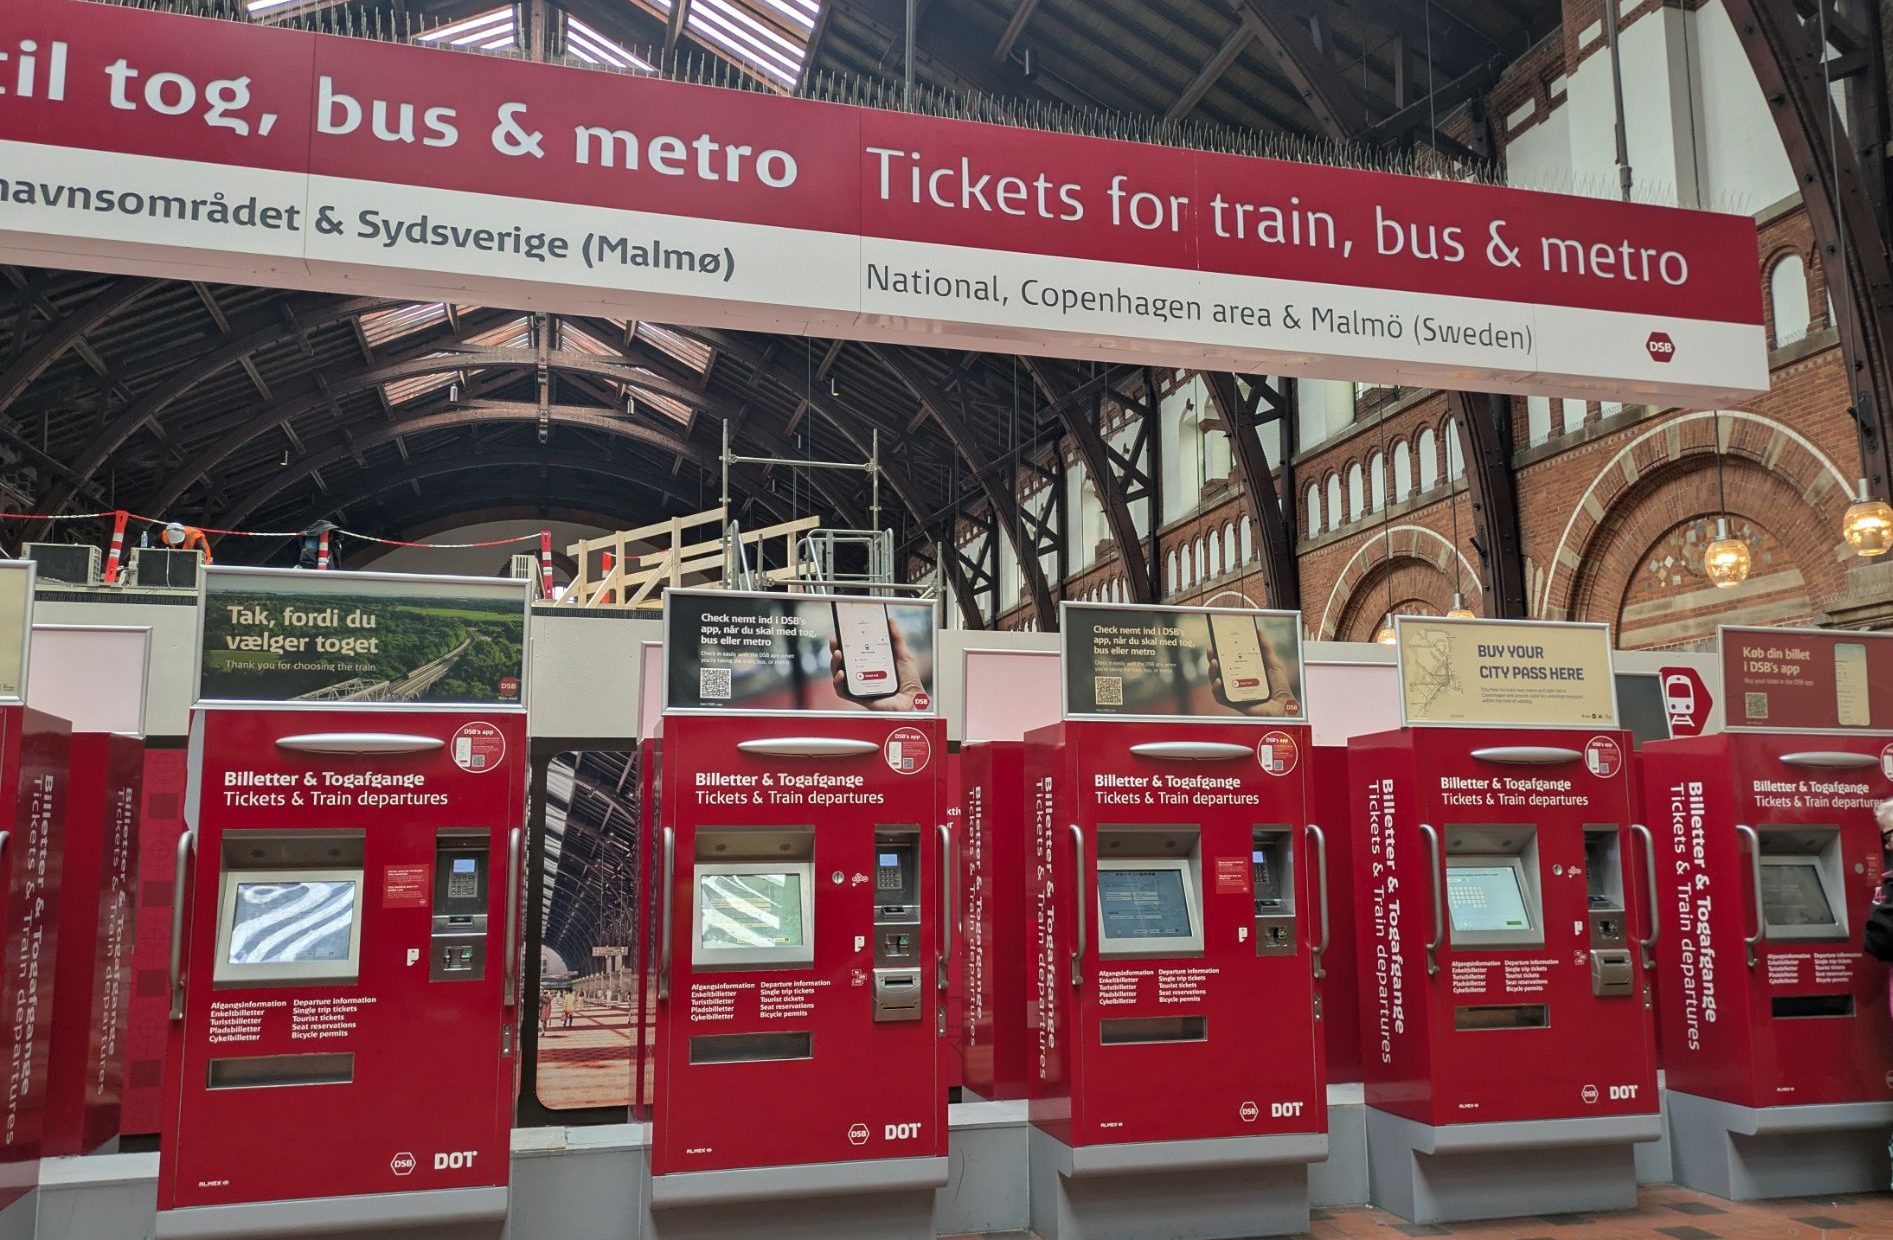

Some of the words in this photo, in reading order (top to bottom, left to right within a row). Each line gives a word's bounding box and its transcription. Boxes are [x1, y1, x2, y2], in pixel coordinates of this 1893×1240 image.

[0, 40, 67, 101] il
[104, 58, 277, 136] tog,
[317, 76, 459, 147] bus
[491, 102, 544, 159] &
[575, 125, 798, 188] metro
[866, 146, 1084, 222] Tickets
[1106, 175, 1189, 232] for
[1210, 193, 1352, 259] train,
[1376, 204, 1465, 263] bus
[1486, 219, 1521, 268] &
[1541, 235, 1688, 286] metro
[315, 205, 344, 235] &
[358, 210, 569, 262] Sydsverige
[582, 233, 735, 282] (Malmø)
[867, 263, 1008, 306] National,
[1020, 279, 1201, 322] Copenhagen
[1212, 303, 1271, 327] area
[1283, 304, 1301, 330] &
[1312, 306, 1403, 339] Malmö
[1414, 314, 1532, 356] (Sweden)
[1649, 340, 1673, 353] DSB
[226, 605, 274, 629] Tak,
[283, 606, 339, 628] fordi
[346, 609, 377, 629] du
[701, 613, 729, 623] Check
[731, 615, 756, 623] nemt
[758, 615, 773, 624] ind
[781, 616, 806, 624] DSB's
[700, 627, 721, 636] app,
[723, 624, 741, 634] når
[743, 626, 754, 635] du
[756, 626, 774, 635] skal
[777, 627, 796, 636] med
[1093, 625, 1118, 634] Check
[1120, 626, 1142, 635] nemt
[1143, 626, 1156, 635] ind
[226, 631, 309, 655] vælger
[316, 636, 379, 657] toget
[701, 636, 718, 645] bus
[720, 636, 741, 645] eller
[743, 638, 771, 646] metro
[1093, 637, 1112, 646] app,
[1113, 636, 1128, 644] når
[1129, 637, 1139, 645] du
[1141, 637, 1158, 645] skal
[1159, 638, 1178, 646] med
[1094, 646, 1109, 654] bus
[1111, 647, 1129, 655] eller
[1131, 648, 1155, 656] metro
[1478, 644, 1505, 658] BUY
[1507, 645, 1543, 659] YOUR
[1743, 647, 1764, 658] Køb
[1767, 648, 1783, 659] din
[1785, 649, 1810, 660] billet
[225, 659, 255, 670] Thank
[257, 662, 275, 672] you
[277, 660, 291, 671] for
[293, 661, 335, 673] choosing
[338, 662, 353, 672] the
[355, 663, 376, 672] train
[1479, 665, 1509, 679] CITY
[1513, 666, 1547, 680] PASS
[1549, 667, 1584, 681] HERE
[1750, 662, 1778, 673] DSB's
[1780, 665, 1800, 675] app
[501, 682, 516, 690] DSB
[224, 771, 300, 786] Billetter
[304, 772, 317, 786] &
[322, 771, 425, 789] Togafgange
[695, 773, 759, 786] Billetter
[763, 773, 774, 786] &
[777, 773, 864, 788] Togafgange
[1095, 774, 1149, 787] Billetter
[1152, 775, 1162, 787] &
[1165, 775, 1241, 789] Togafgange
[1441, 777, 1489, 789] Billetter
[1492, 778, 1501, 789] &
[1503, 778, 1571, 792] Togafgange
[1753, 780, 1796, 792] Billetter
[1799, 781, 1807, 792] &
[1809, 781, 1869, 794] Togafgange
[224, 791, 285, 806] Tickets
[291, 792, 304, 806] &
[311, 791, 352, 806] Train
[358, 791, 449, 808] departures
[695, 791, 748, 804] Tickets
[752, 791, 763, 804] &
[768, 791, 803, 804] Train
[808, 790, 884, 806] departures
[1095, 792, 1141, 804] Tickets
[1145, 792, 1154, 804] &
[1158, 792, 1189, 804] Train
[1193, 791, 1259, 806] departures
[1442, 793, 1482, 805] Tickets
[1486, 793, 1495, 805] &
[1498, 793, 1526, 805] Train
[1529, 794, 1588, 808] departures
[1755, 795, 1791, 807] Tickets
[1794, 796, 1802, 807] &
[1805, 796, 1829, 807] Train
[27, 774, 42, 870] Tickets
[1368, 780, 1380, 854] Tickets
[1382, 779, 1396, 870] Billetter
[1670, 783, 1686, 853] Tickets
[37, 775, 53, 888] Billetter
[1688, 782, 1705, 868] Billetter
[1372, 862, 1383, 877] &
[1676, 860, 1690, 875] &
[1387, 876, 1398, 892] &
[1695, 874, 1710, 889] &
[26, 880, 34, 900] &
[35, 897, 44, 917] &
[1373, 886, 1384, 936] Train
[1677, 882, 1691, 931] Train
[19, 914, 33, 978] Train
[1388, 899, 1404, 1034] Togafgange
[1696, 896, 1716, 1023] Togafgange
[293, 998, 330, 1008] Departure
[332, 996, 377, 1005] information
[1681, 939, 1699, 1050] departures
[21, 925, 43, 1097] Togafgange
[211, 999, 287, 1010] Afgangsinformation
[293, 1006, 315, 1016] Single
[317, 1005, 331, 1015] trip
[333, 1004, 357, 1013] tickets
[1377, 944, 1391, 1063] departures
[210, 1009, 265, 1017] Enkeltbilletter
[292, 1014, 318, 1023] Tourist
[320, 1013, 344, 1021] tickets
[210, 1017, 261, 1026] Turistbilletter
[292, 1022, 308, 1031] Seat
[310, 1021, 356, 1030] reservations
[209, 1025, 261, 1034] Pladsbilletter
[291, 1030, 317, 1040] Bicycle
[319, 1029, 348, 1039] permits
[208, 1033, 260, 1044] Cykelbilletter
[6, 988, 25, 1145] departures
[1609, 1085, 1638, 1100] DOT
[1271, 1101, 1303, 1117] DOT
[885, 1122, 922, 1140] DOT
[394, 1159, 412, 1168] DSB
[434, 1151, 477, 1170] DOT
